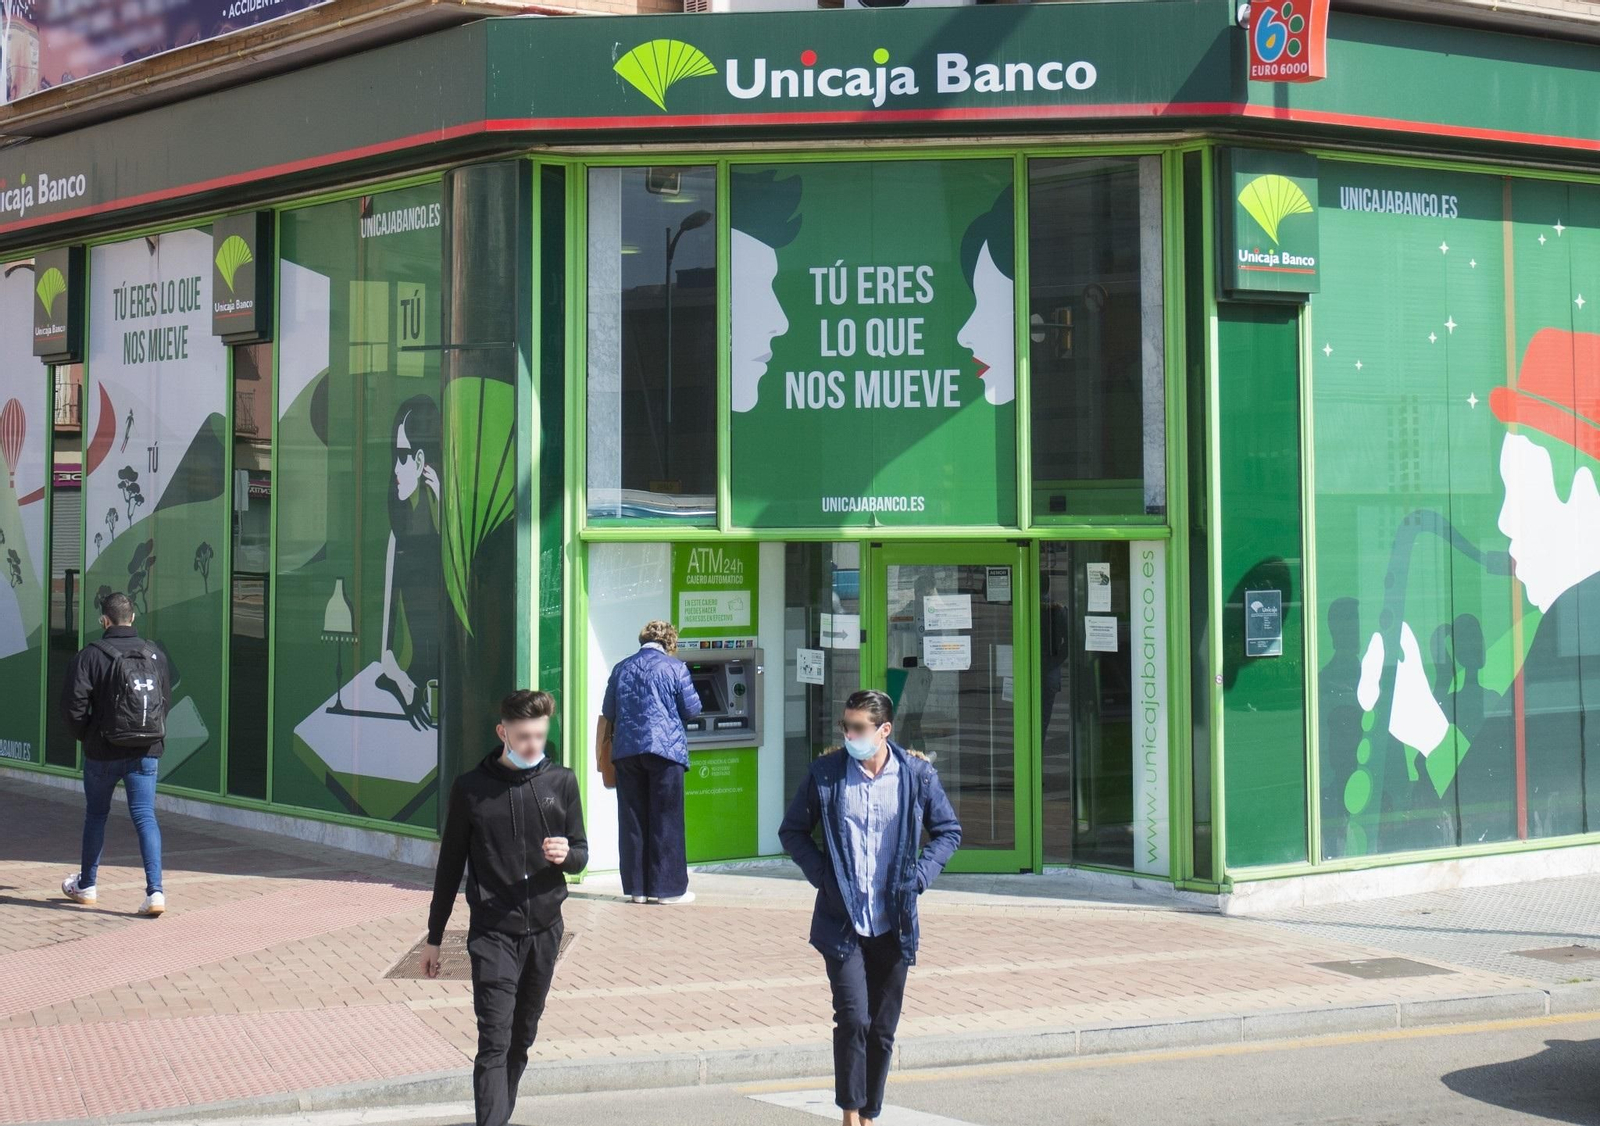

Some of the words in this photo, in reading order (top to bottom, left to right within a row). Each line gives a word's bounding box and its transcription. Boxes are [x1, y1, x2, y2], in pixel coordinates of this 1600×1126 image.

[726, 48, 919, 107] Unicaja
[936, 53, 1097, 95] Banco
[1252, 64, 1278, 76] EURO
[1280, 63, 1307, 75] 6000
[38, 173, 86, 204] Banco
[1340, 186, 1458, 219] UNICAJABANCO.ES
[361, 203, 440, 238] UNICAJABANCO.ES
[1238, 247, 1280, 267] Unicaja
[1281, 251, 1315, 266] Banco
[113, 281, 127, 321] TÚ
[130, 283, 157, 319] ERES
[161, 280, 175, 315] LO
[179, 276, 201, 313] QUE
[809, 260, 847, 305] TÚ
[857, 265, 934, 304] ERES
[214, 299, 235, 313] Unicaja
[235, 299, 253, 310] Banco
[400, 290, 421, 341] TÚ
[123, 331, 146, 365] NOS
[148, 325, 189, 363] MUEVE
[820, 318, 856, 357] LO
[865, 317, 925, 358] QUE
[785, 371, 845, 409] NOS
[854, 369, 961, 409] MUEVE
[147, 440, 159, 474] TÚ
[822, 496, 925, 512] UNICAJABANCO.ES
[687, 548, 723, 573] ATM
[723, 558, 744, 574] 24h
[686, 575, 707, 585] CAJERO
[1140, 550, 1160, 863] www.unicajabanco.es
